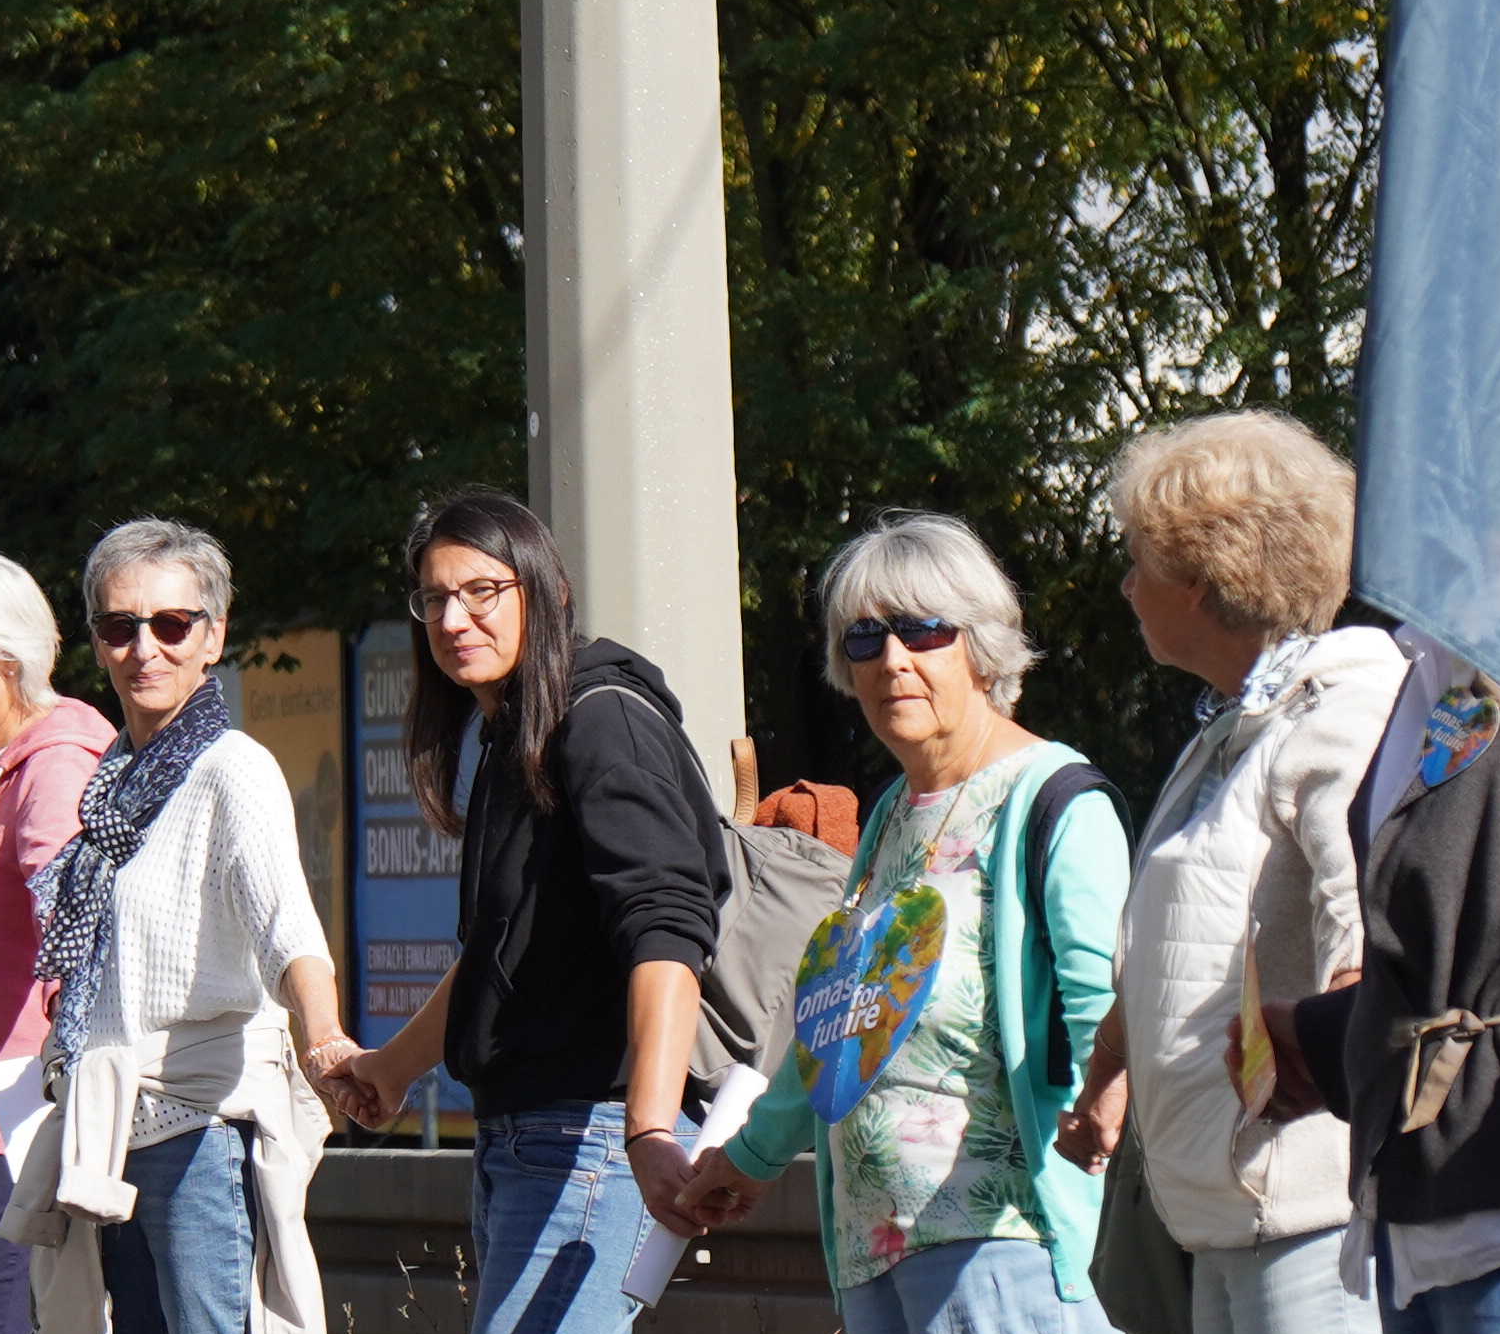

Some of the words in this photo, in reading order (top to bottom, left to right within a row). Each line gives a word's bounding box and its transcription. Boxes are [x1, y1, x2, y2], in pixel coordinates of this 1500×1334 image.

[1431, 708, 1463, 728] omas
[1432, 726, 1465, 752] future
[797, 971, 859, 1024] omas
[850, 981, 883, 1011] for
[810, 1003, 881, 1053] future
